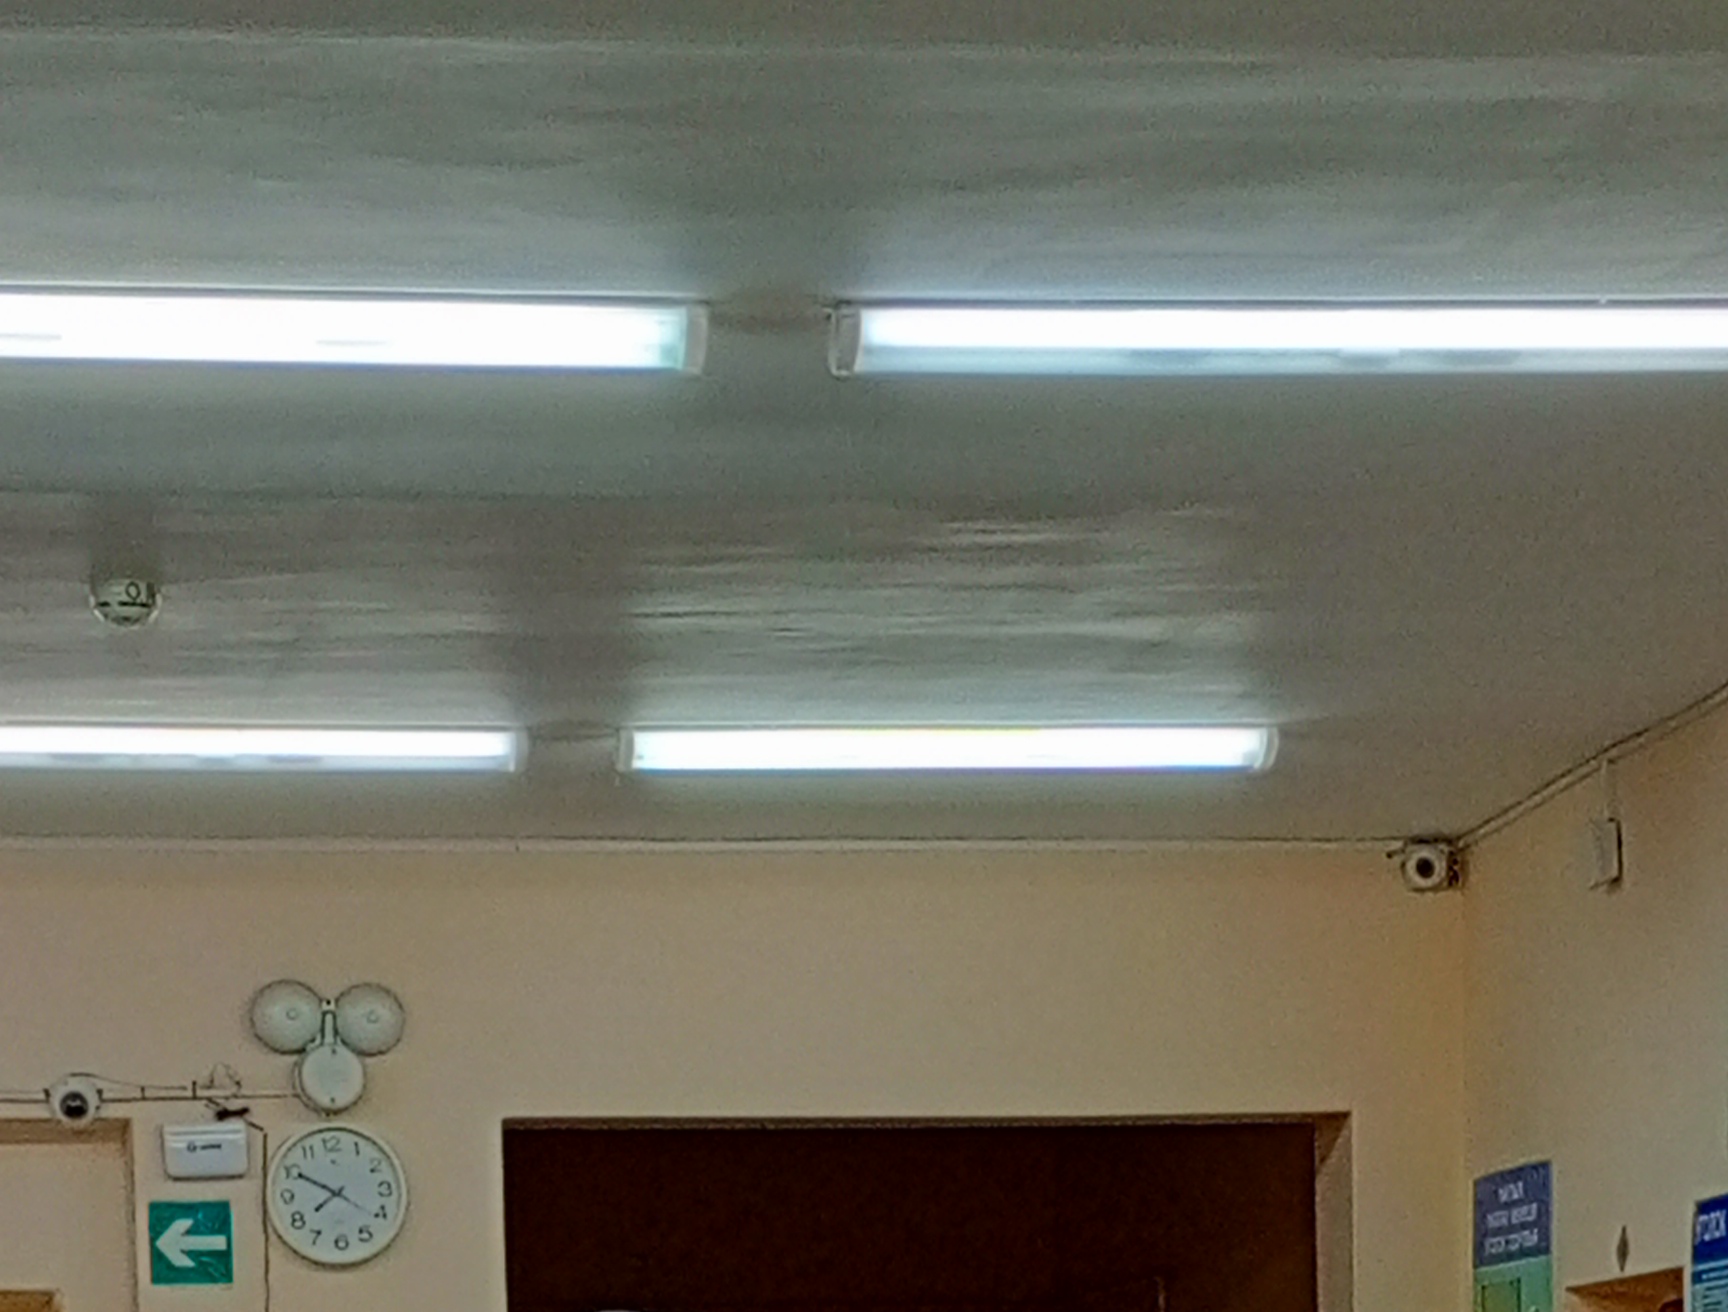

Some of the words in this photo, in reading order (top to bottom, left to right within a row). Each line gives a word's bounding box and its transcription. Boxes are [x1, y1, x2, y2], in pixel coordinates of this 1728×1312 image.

[301, 1144, 315, 1160] 11
[321, 1135, 342, 1153] 12
[369, 1157, 382, 1174] 2
[280, 1188, 295, 1205] 9
[377, 1180, 393, 1198] 3
[290, 1210, 306, 1230] 8
[373, 1204, 387, 1220] 4
[309, 1228, 322, 1245] 7
[357, 1224, 374, 1243] 5
[334, 1234, 350, 1251] 6
